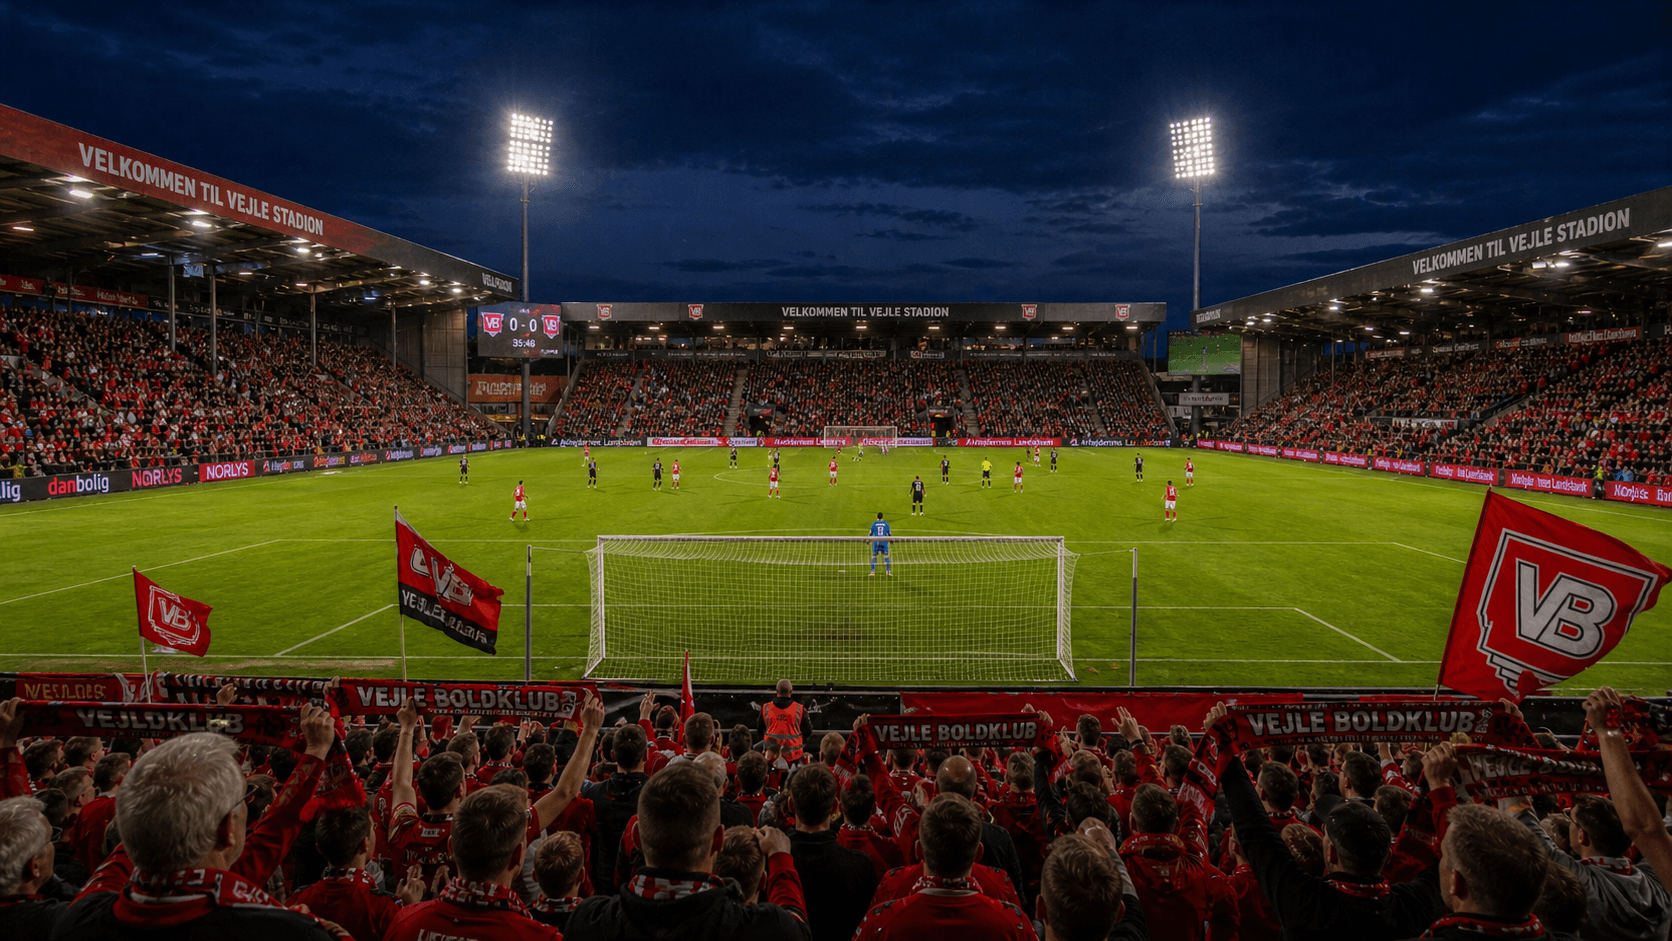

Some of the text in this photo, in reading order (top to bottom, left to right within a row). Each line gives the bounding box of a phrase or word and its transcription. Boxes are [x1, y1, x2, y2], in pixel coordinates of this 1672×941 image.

[78, 143, 324, 236] VELKOMMEN TIL VEJLE STADION
[1412, 207, 1631, 275] VELKOMMEN TIL VEJLE STADION
[781, 306, 949, 317] VELKOMMEN TIL VEJLE STADION
[485, 316, 500, 329] VB
[509, 317, 518, 332] 0
[529, 318, 538, 333] 0
[132, 467, 182, 488] NORLYS
[206, 461, 249, 480] NORLYS
[0, 481, 21, 502] lig
[47, 474, 110, 495] danbolig
[158, 597, 191, 631] VB
[1515, 558, 1618, 660] VB
[434, 688, 559, 712] BOLDKLUB
[874, 721, 1038, 742] VEJLE BOLDKLUB
[1246, 710, 1476, 737] VEJLE BOLDKLUB
